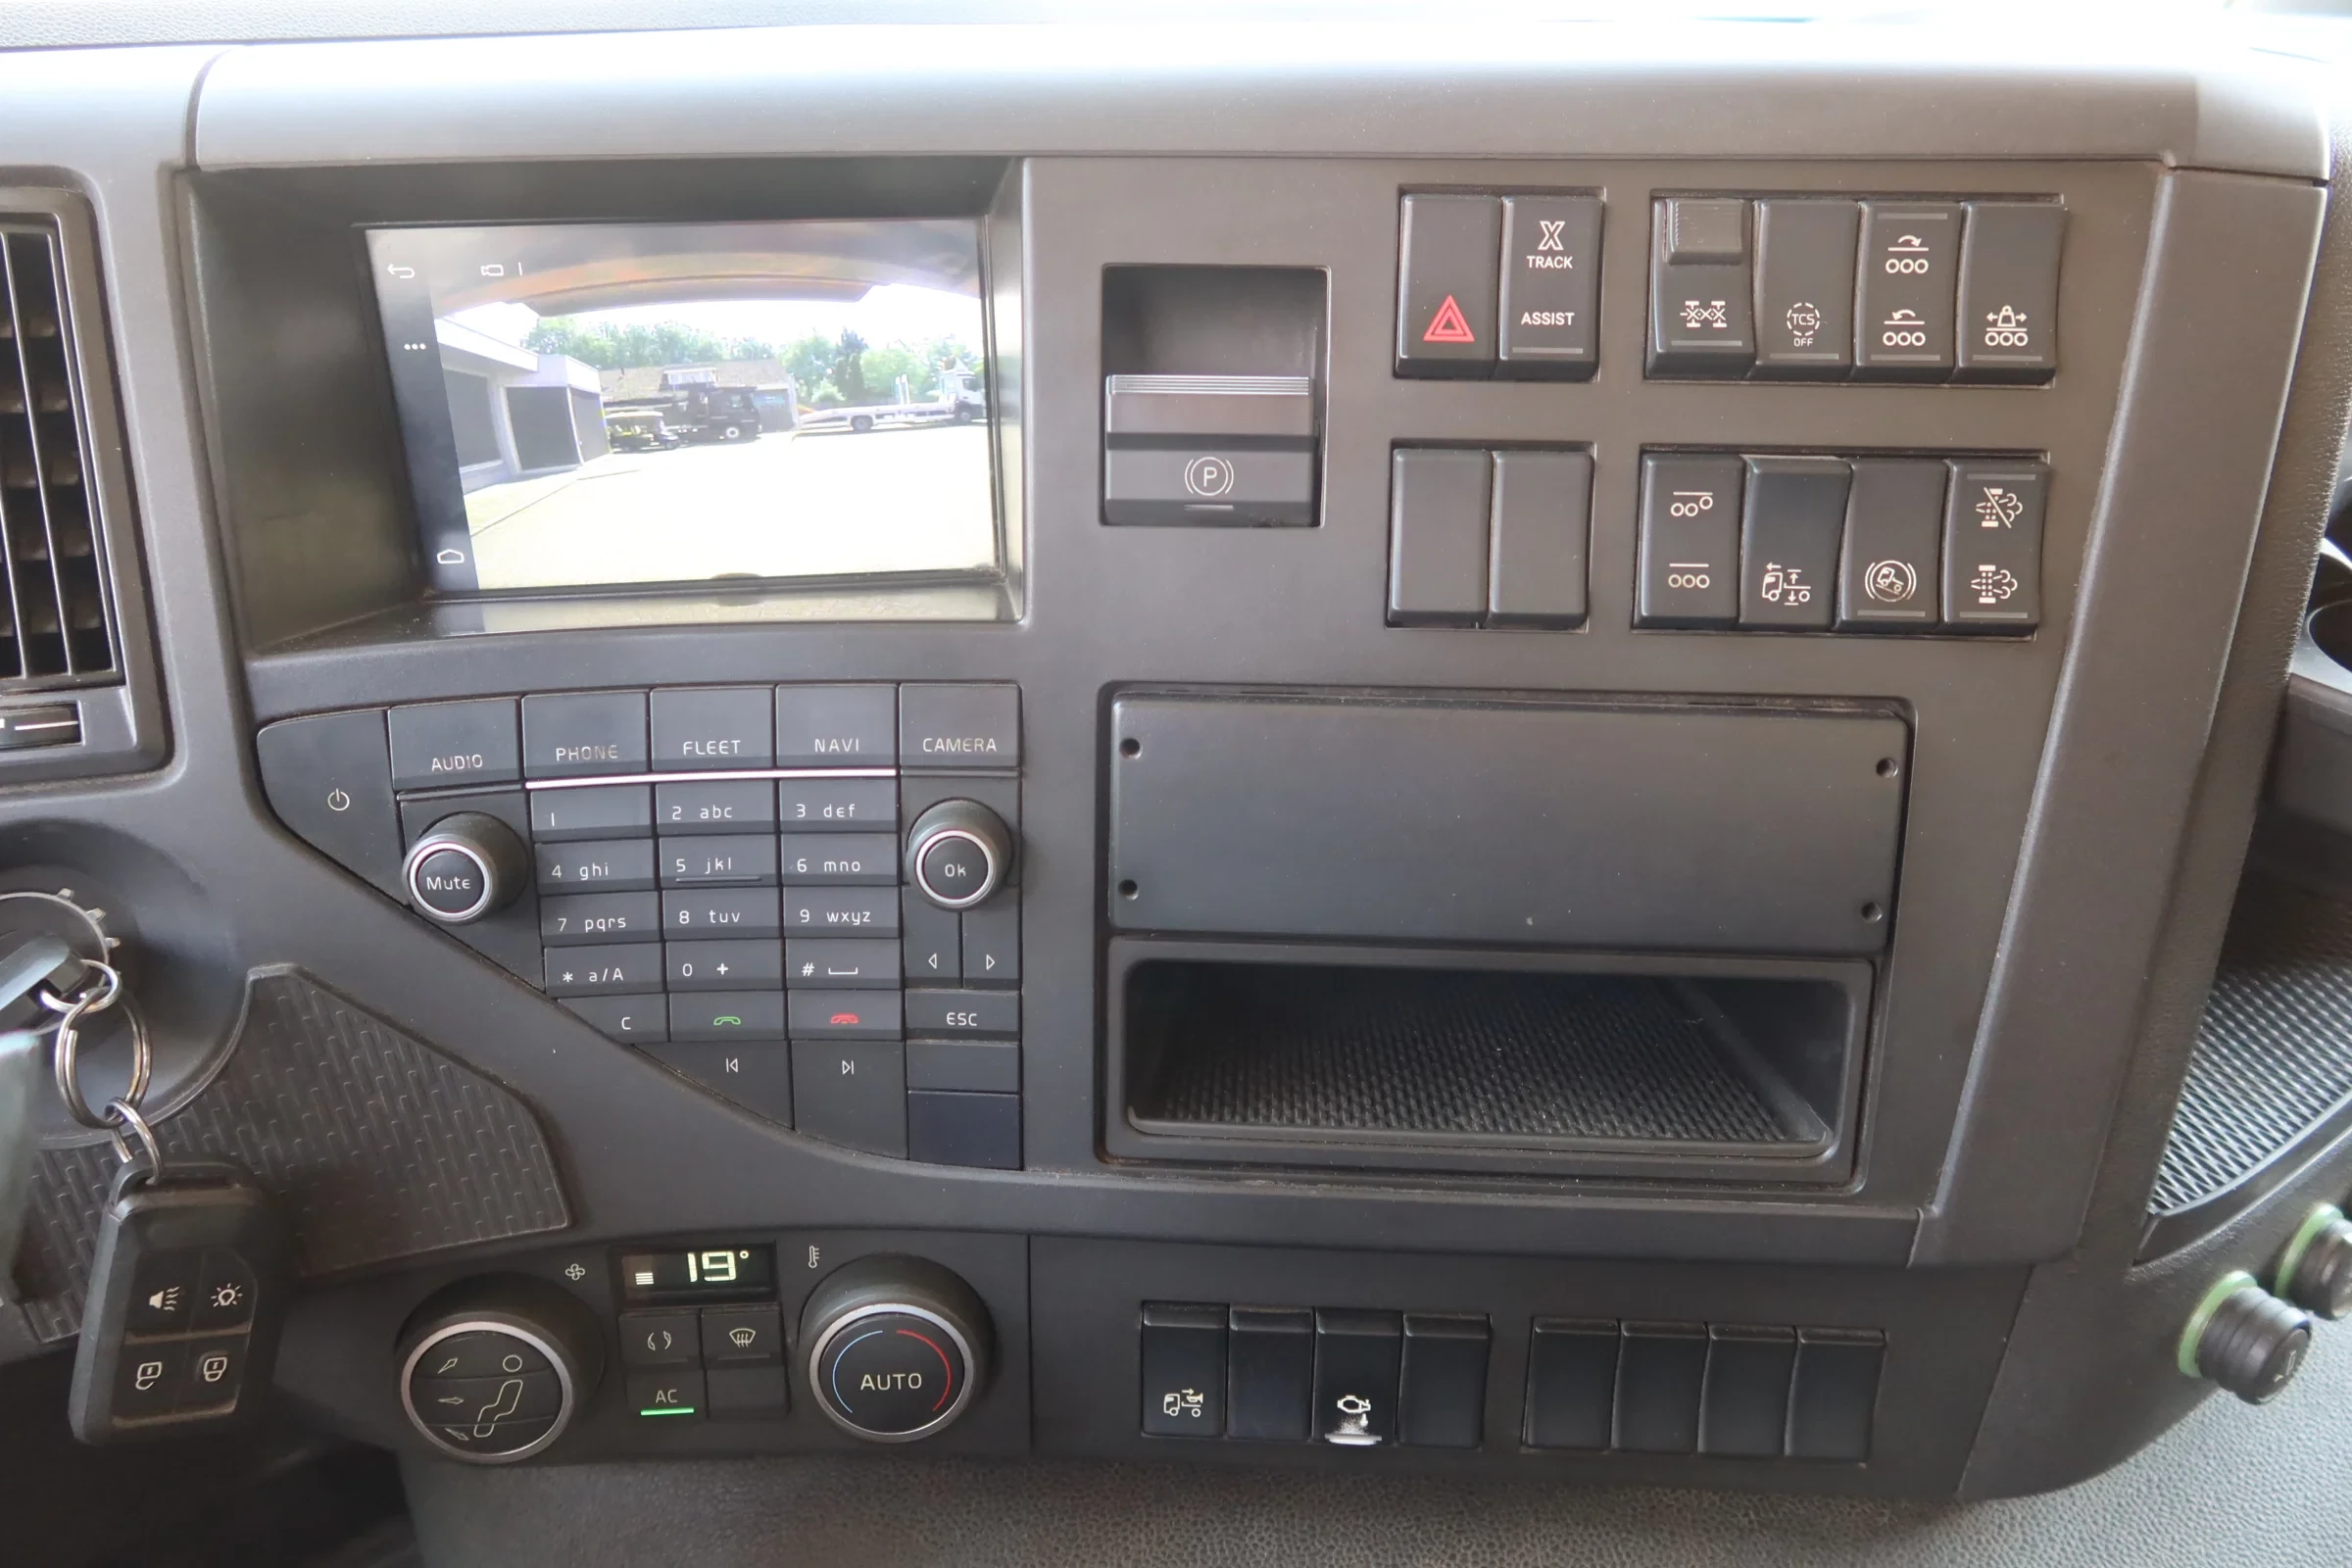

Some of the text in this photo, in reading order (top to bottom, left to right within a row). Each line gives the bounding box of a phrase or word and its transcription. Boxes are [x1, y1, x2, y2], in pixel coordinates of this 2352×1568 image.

[1526, 255, 1574, 270] TRACK
[1520, 311, 1575, 326] ASSIST
[1790, 313, 1815, 326] TCS
[1793, 337, 1814, 347] OFF
[1202, 466, 1218, 487] P
[556, 744, 618, 762] PHONE
[682, 739, 741, 756] FLEET
[814, 738, 859, 753] NAVI
[922, 737, 997, 753] CAMERA
[431, 754, 483, 772] AUDIO
[671, 804, 733, 820] 2 abc
[796, 803, 856, 818] 3 def
[551, 862, 609, 881] 4 ghi
[675, 857, 732, 875] 5 jkl
[797, 858, 861, 873] 6 mno
[944, 863, 966, 878] Ok
[425, 876, 470, 891] Mute
[557, 917, 626, 933] 7 pqrs
[678, 909, 741, 925] 8 tuv
[800, 908, 871, 926] 9 wxyz
[588, 967, 624, 983] a/A
[801, 962, 815, 977] #
[620, 1016, 631, 1031] C
[946, 1011, 978, 1027] ESC
[859, 1372, 922, 1391] AUTO
[655, 1389, 678, 1403] AC
